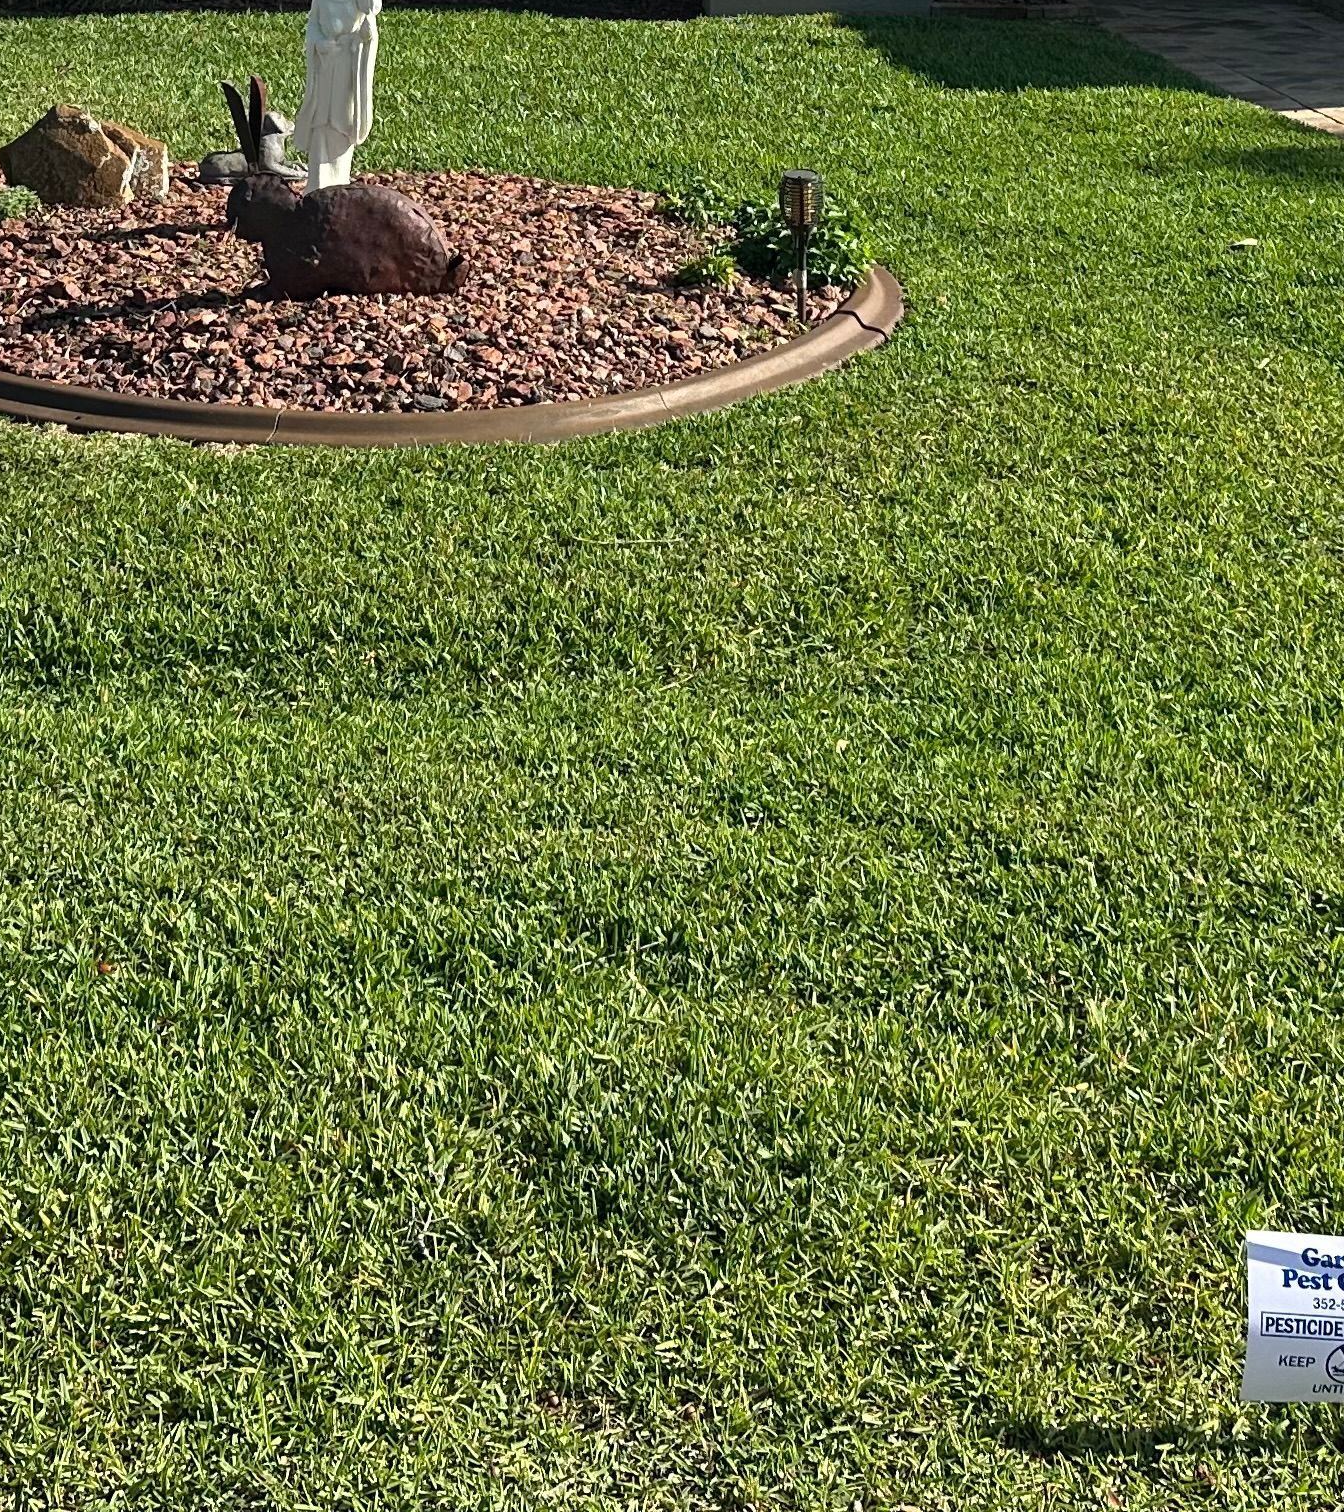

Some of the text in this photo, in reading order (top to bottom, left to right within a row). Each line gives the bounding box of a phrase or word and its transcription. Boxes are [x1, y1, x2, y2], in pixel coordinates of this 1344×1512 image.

[1282, 1268, 1333, 1291] Pest
[1265, 1316, 1344, 1338] PESTICIDE
[1278, 1354, 1316, 1368] KEEP
